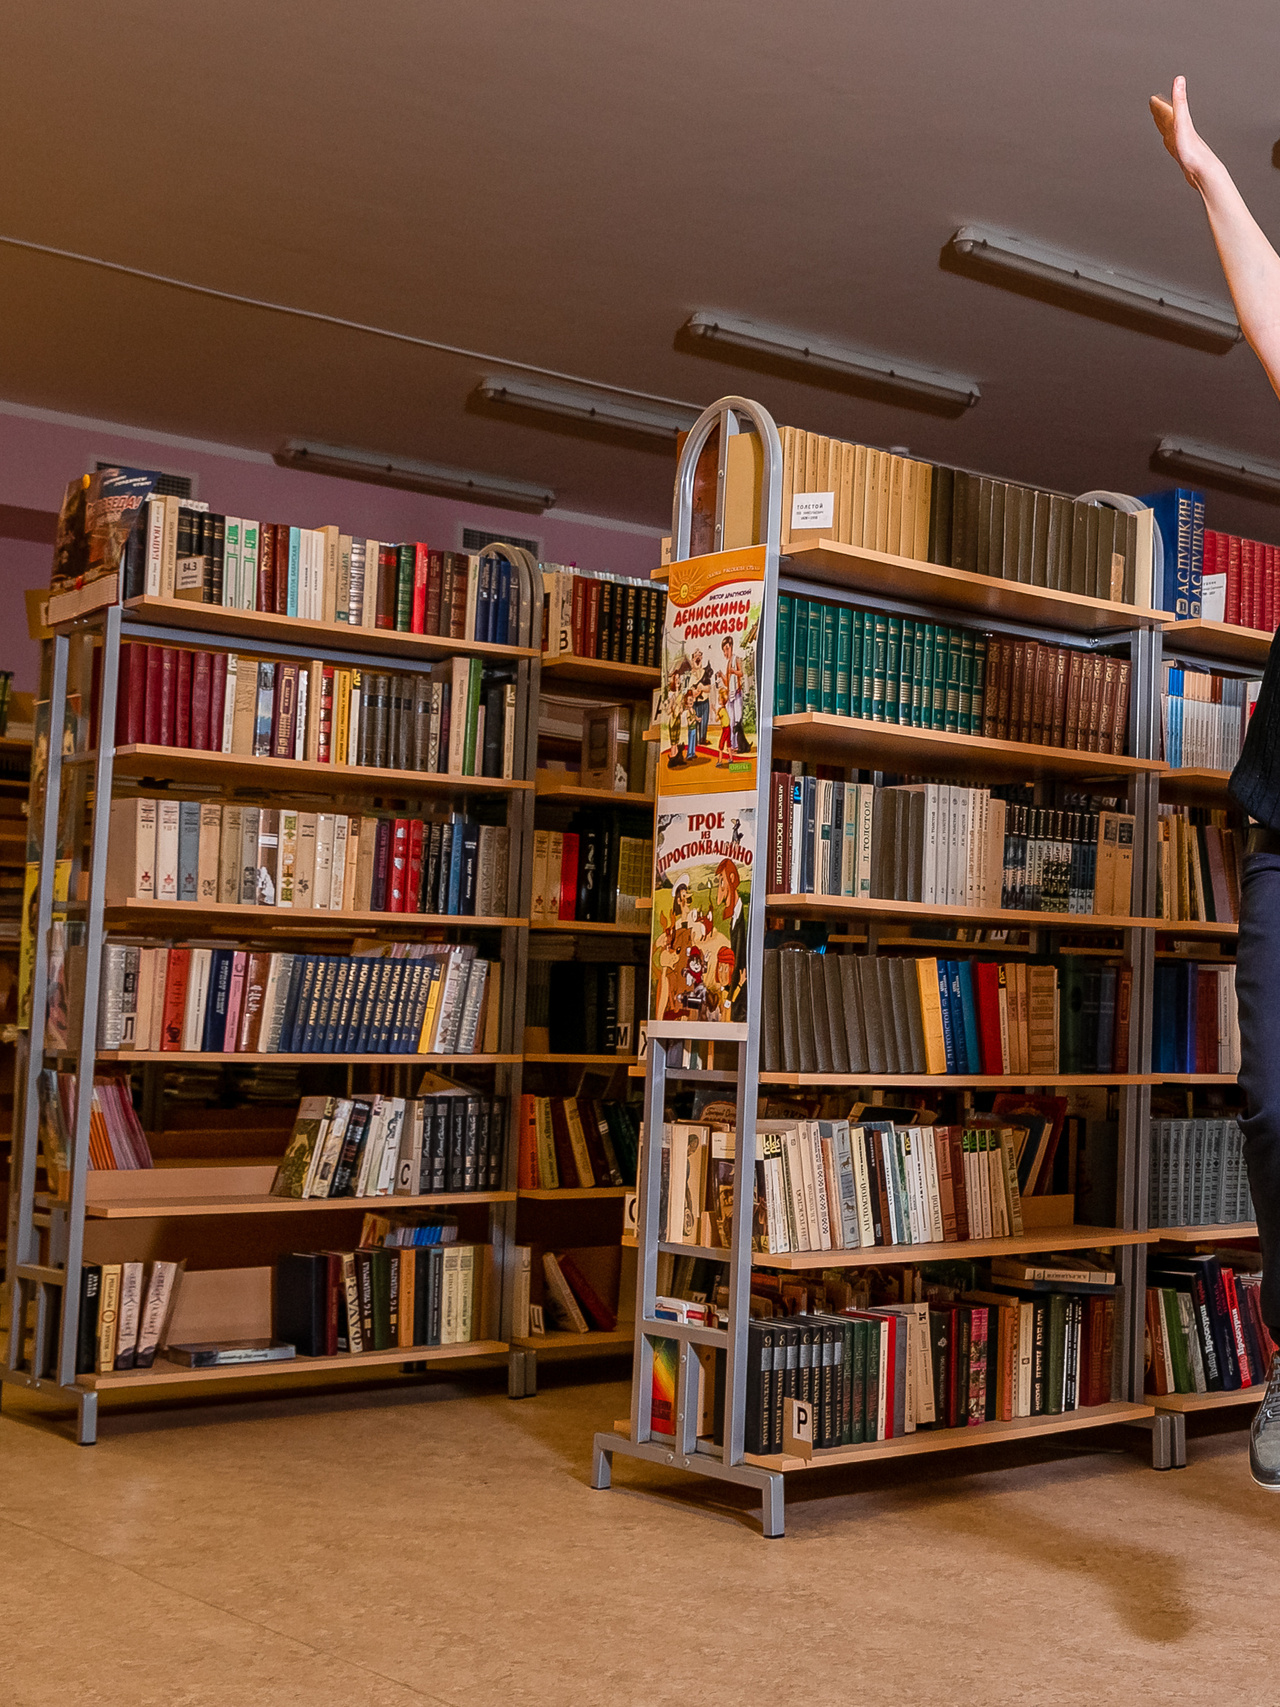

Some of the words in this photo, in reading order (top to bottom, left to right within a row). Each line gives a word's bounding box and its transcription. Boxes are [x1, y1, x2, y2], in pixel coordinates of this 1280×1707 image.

[709, 592, 724, 601] ВИКТОР
[724, 588, 752, 599] ДРАГУНСКИЙ
[673, 598, 751, 628] ДЕНИСКИНЫ
[684, 616, 749, 640] РАССКАЗЫ
[687, 811, 725, 832] ТРОЕ
[700, 830, 711, 840] ИЗ
[862, 801, 871, 852] ТОЛСТОЙ
[657, 839, 753, 873] ПРОСТОКВАШИНО
[401, 1163, 410, 1185] С
[1036, 1309, 1044, 1346] АРБАТА
[1200, 1304, 1213, 1352] Проскурин
[1232, 1308, 1244, 1356] Проскурин
[797, 1406, 807, 1434] Р
